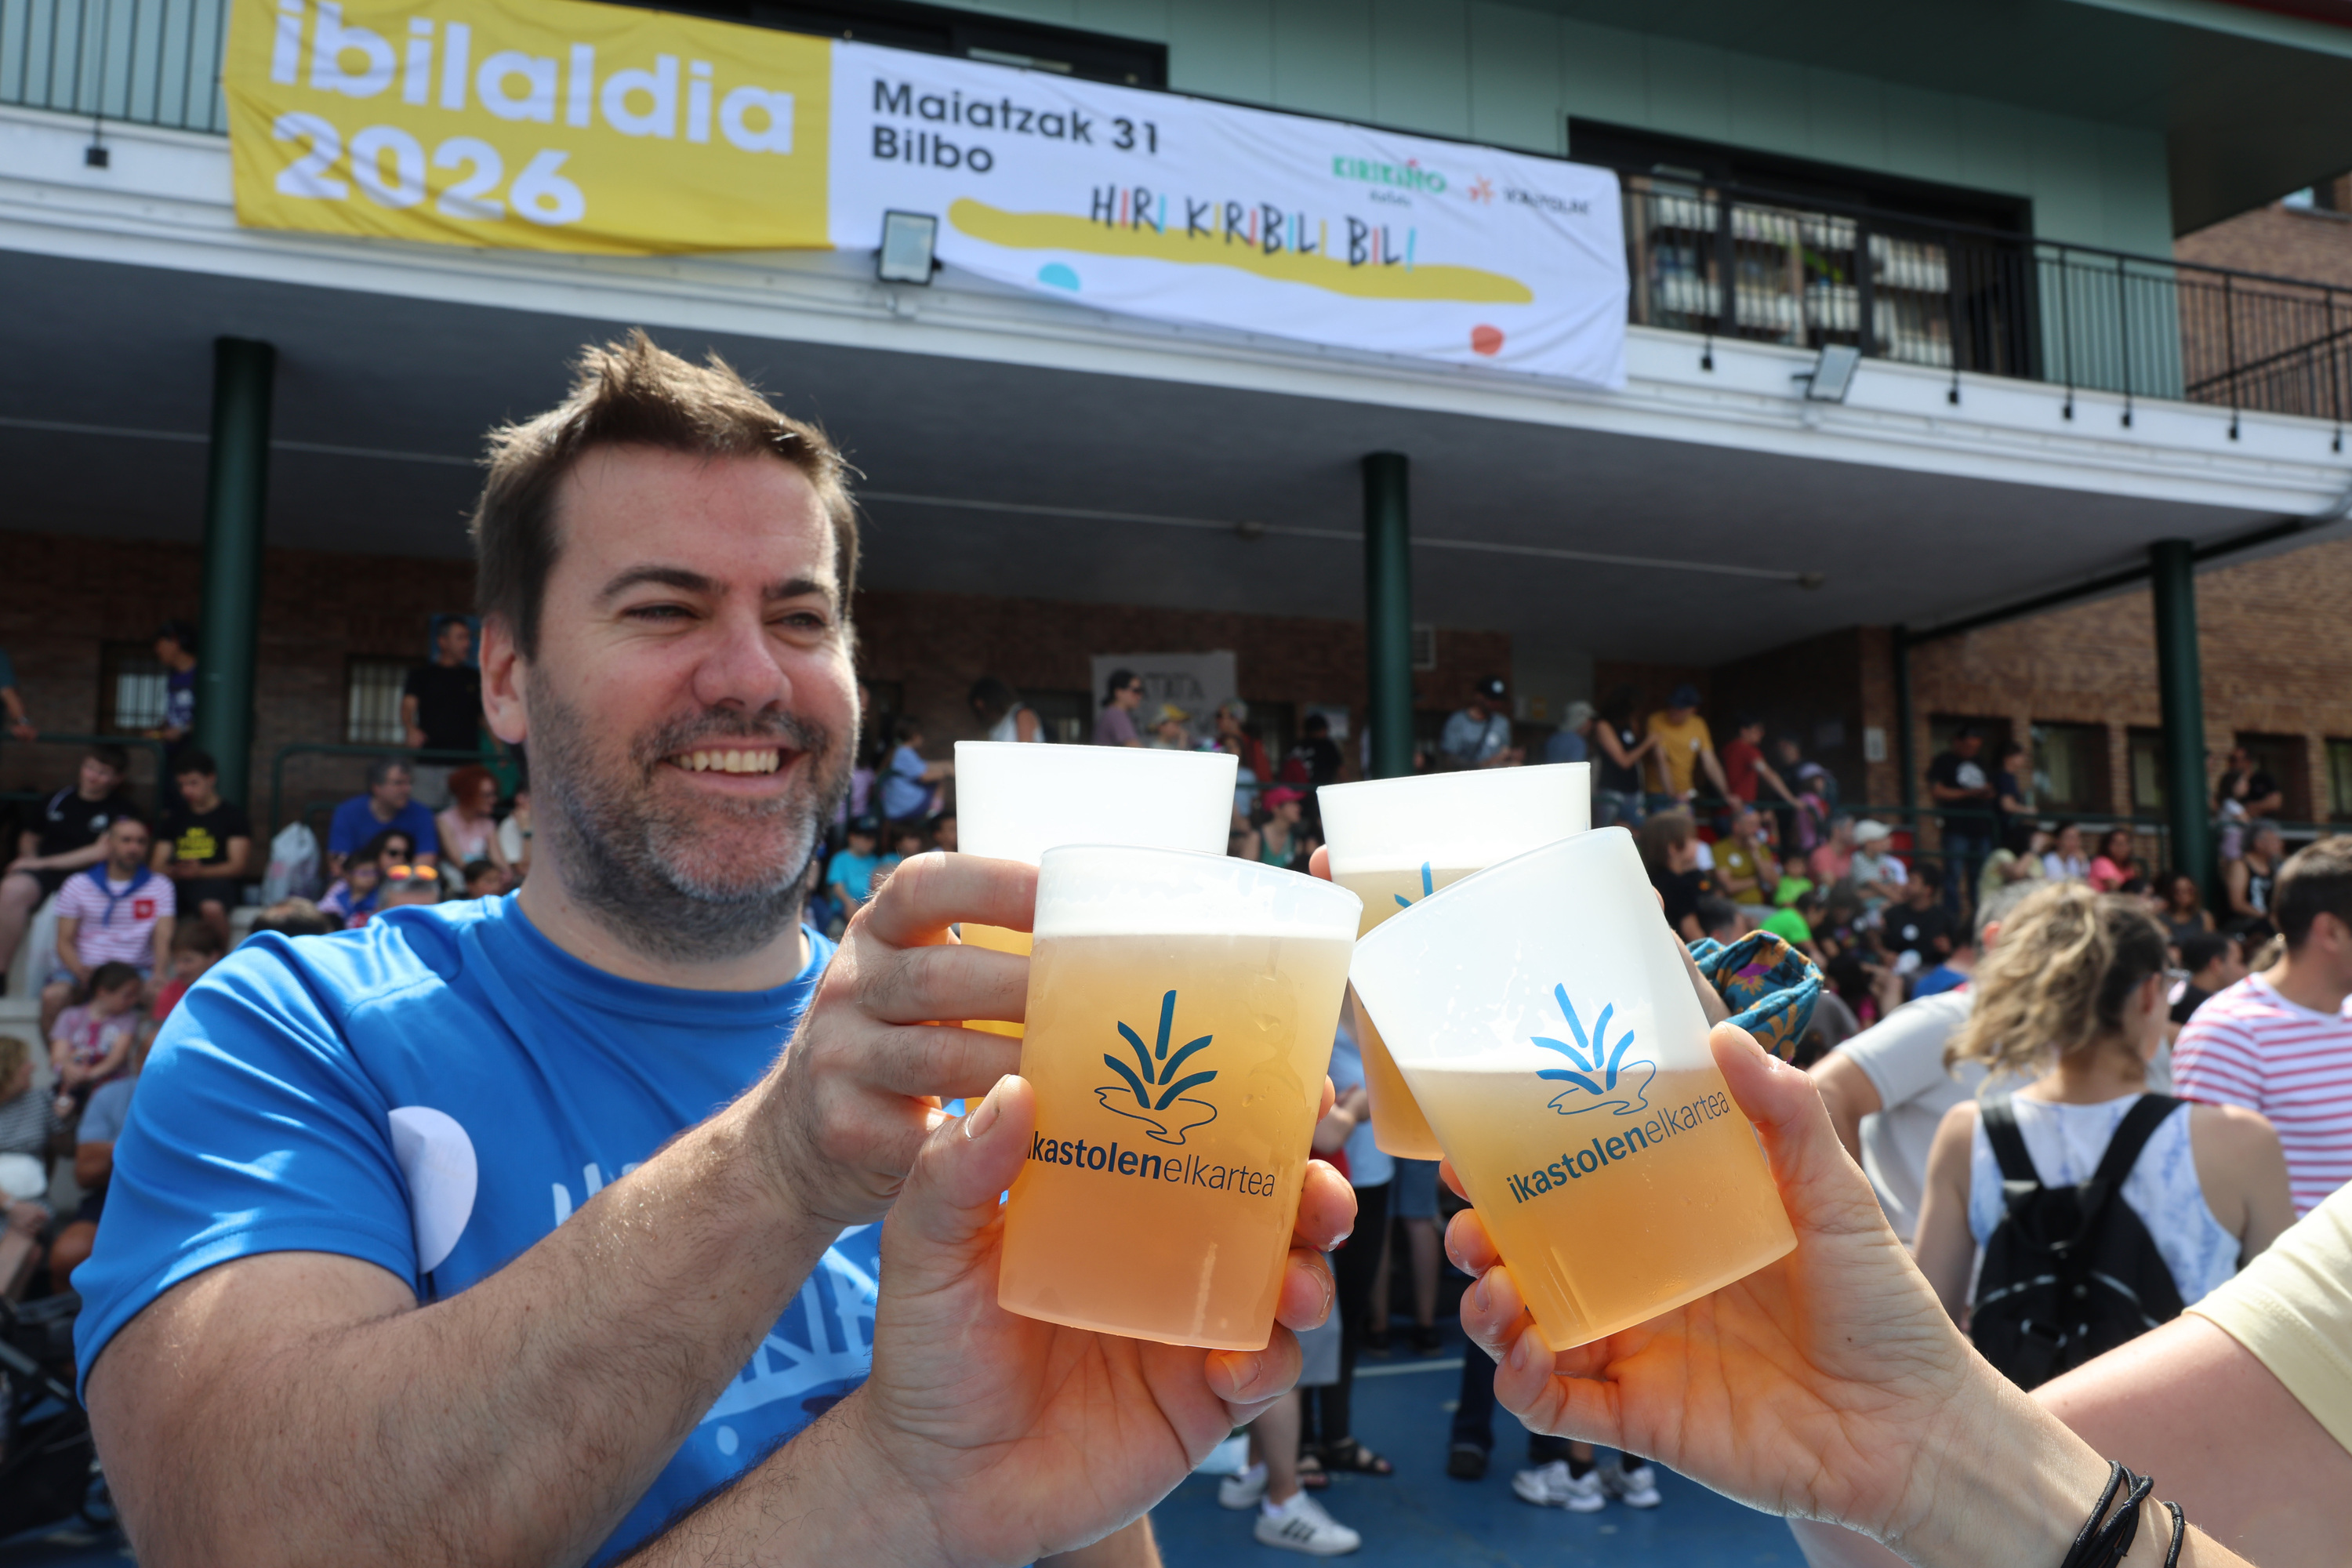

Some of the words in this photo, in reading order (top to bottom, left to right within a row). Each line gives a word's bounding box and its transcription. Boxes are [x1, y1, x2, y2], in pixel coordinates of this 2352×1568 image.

[269, 0, 796, 156] ibilaldia
[872, 78, 1093, 145] Maiatzak
[1112, 117, 1158, 154] 31
[270, 111, 587, 226] 2026
[872, 125, 994, 174] Bilbo
[1090, 183, 1167, 236] HIRI
[1344, 213, 1417, 273] BILI
[1506, 1091, 1730, 1205] ikastolenelkartea
